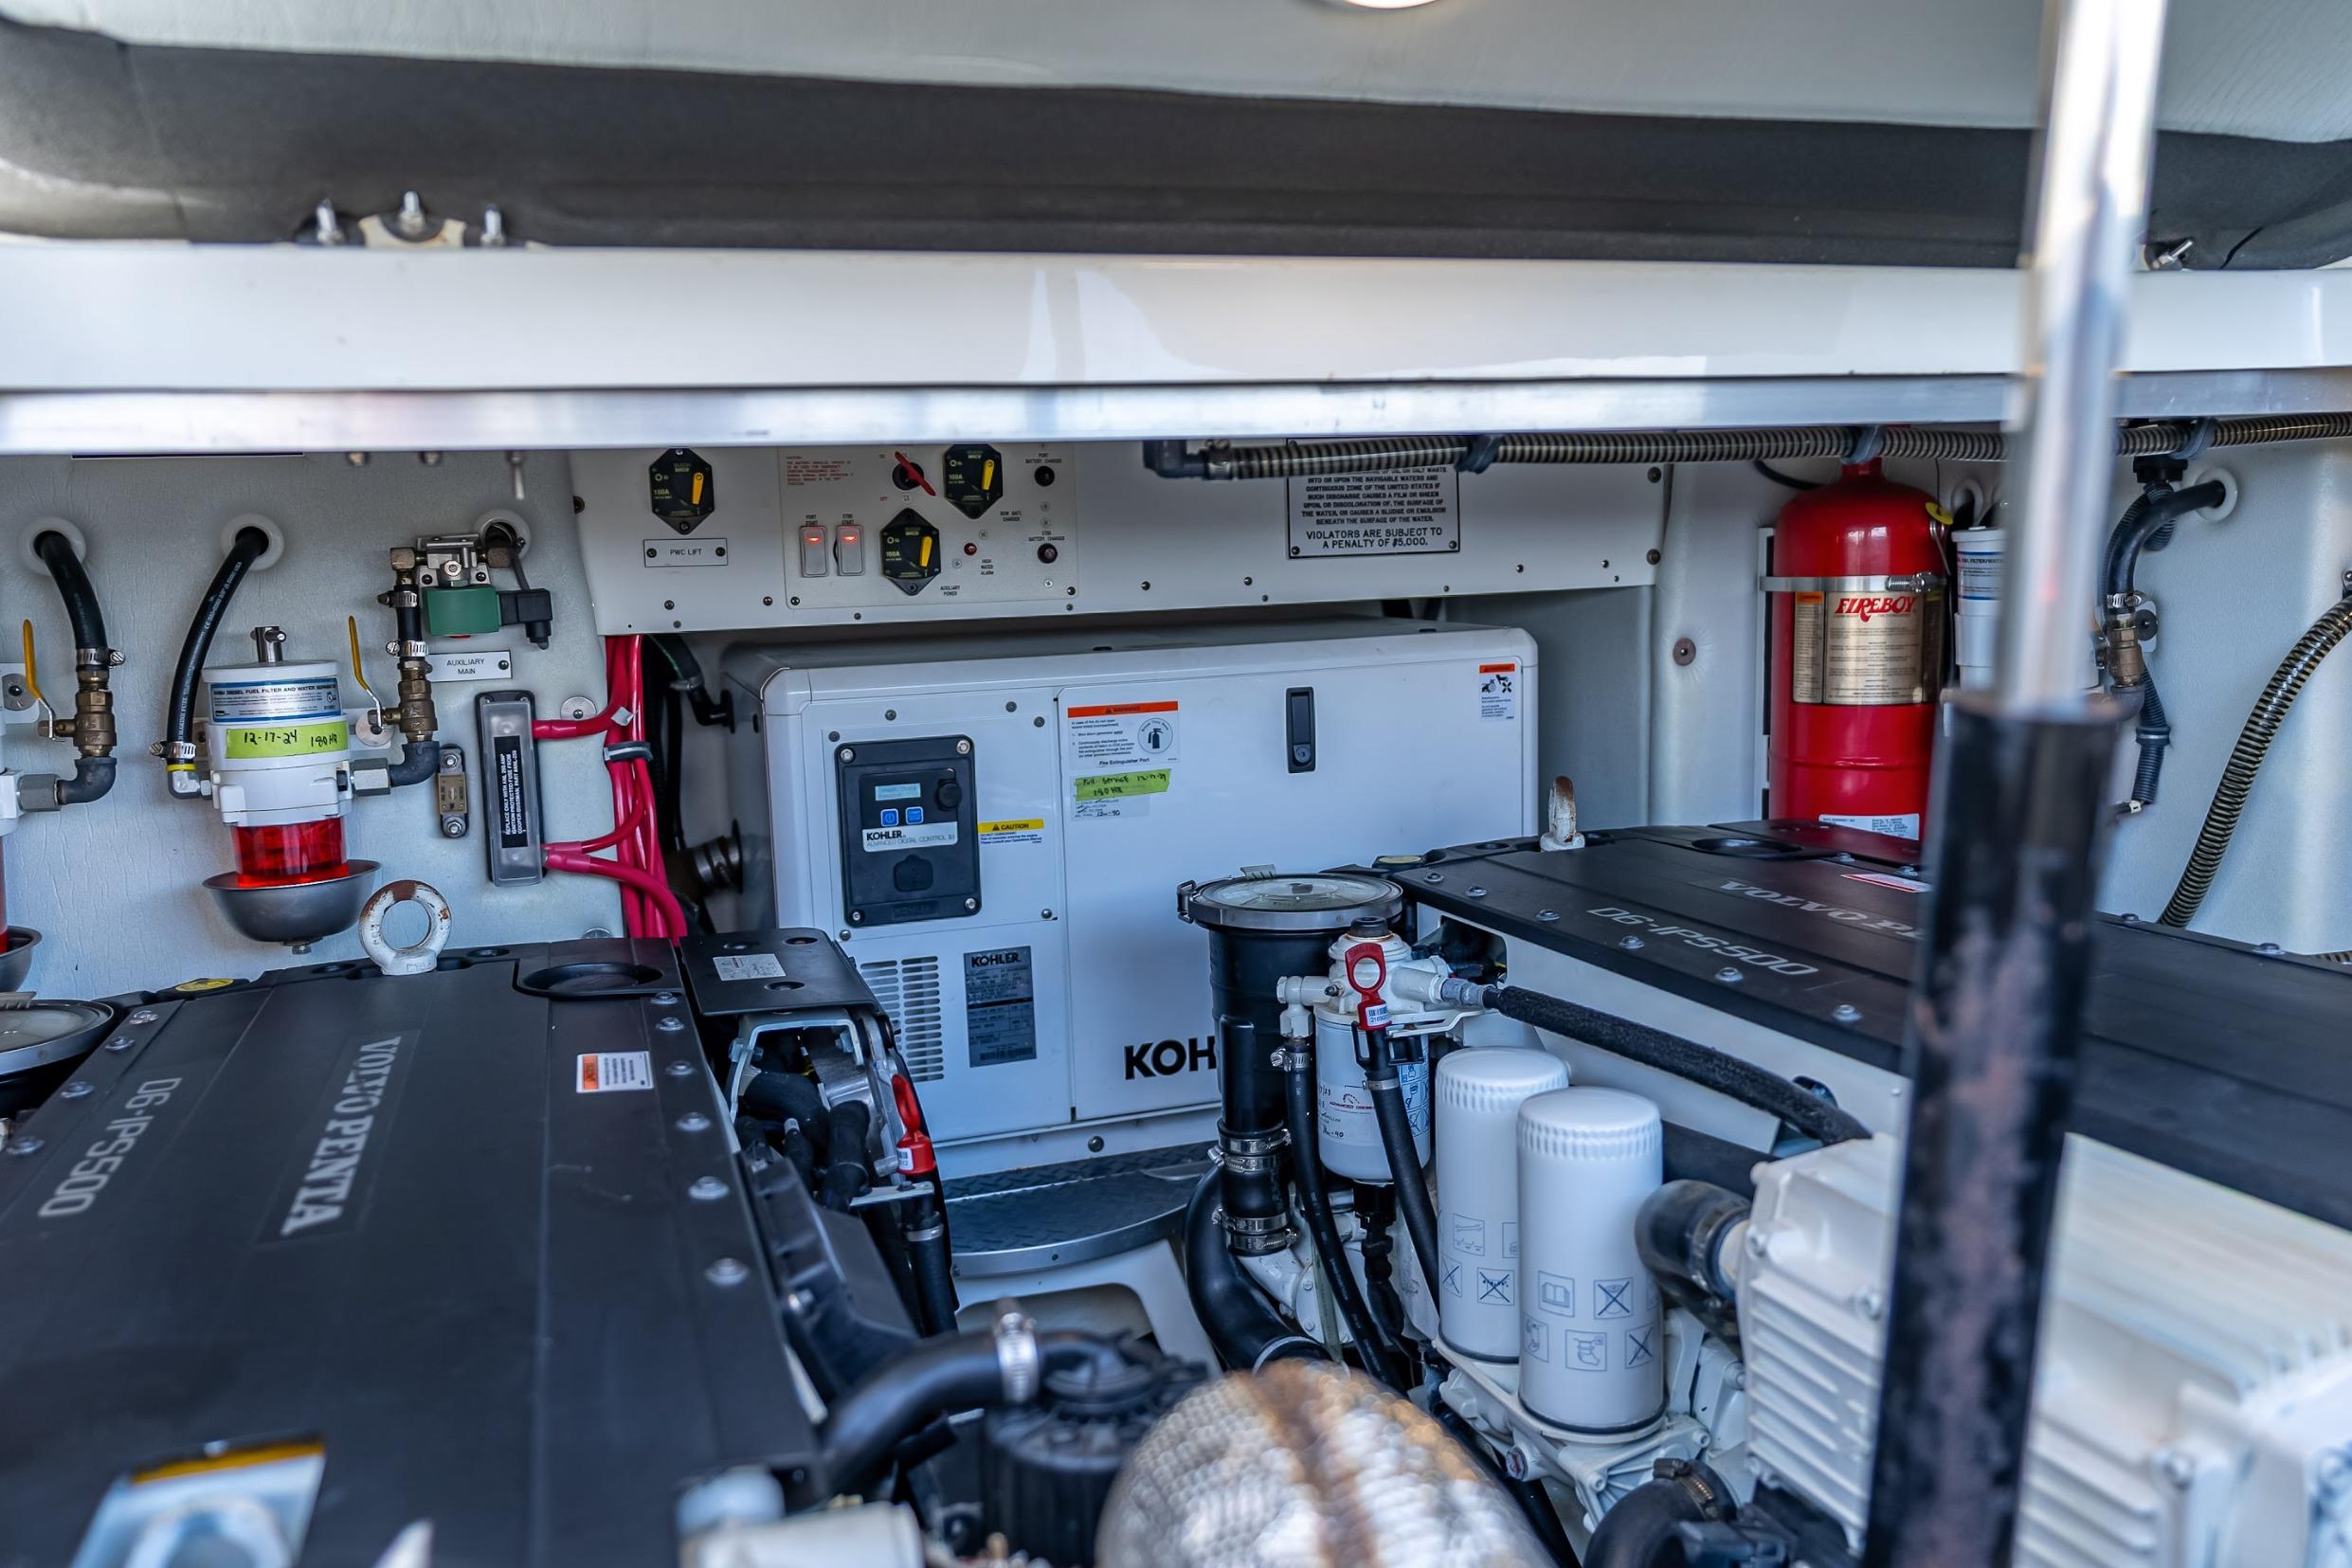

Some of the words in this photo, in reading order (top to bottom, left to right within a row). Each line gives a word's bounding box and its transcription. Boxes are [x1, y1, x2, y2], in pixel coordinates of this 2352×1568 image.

[1306, 531, 1360, 540] VIOLATORS
[1363, 530, 1382, 538] ARE
[1385, 528, 1427, 537] SUBJECT
[1430, 527, 1442, 536] TO
[1323, 540, 1329, 549] A
[1332, 539, 1374, 549] PENALTY
[1378, 538, 1390, 547] OF
[1835, 596, 1918, 622] FIREBOY
[244, 730, 298, 746] 12-17-24
[866, 830, 902, 840] KOHLER
[1720, 881, 1868, 920] VOLVO
[1586, 907, 1819, 976] D6-IPS500
[970, 952, 1021, 967] KOHLER
[334, 1036, 402, 1113] VOLVO
[37, 1077, 183, 1217] D6-IPS500
[280, 1114, 374, 1235] PENTA
